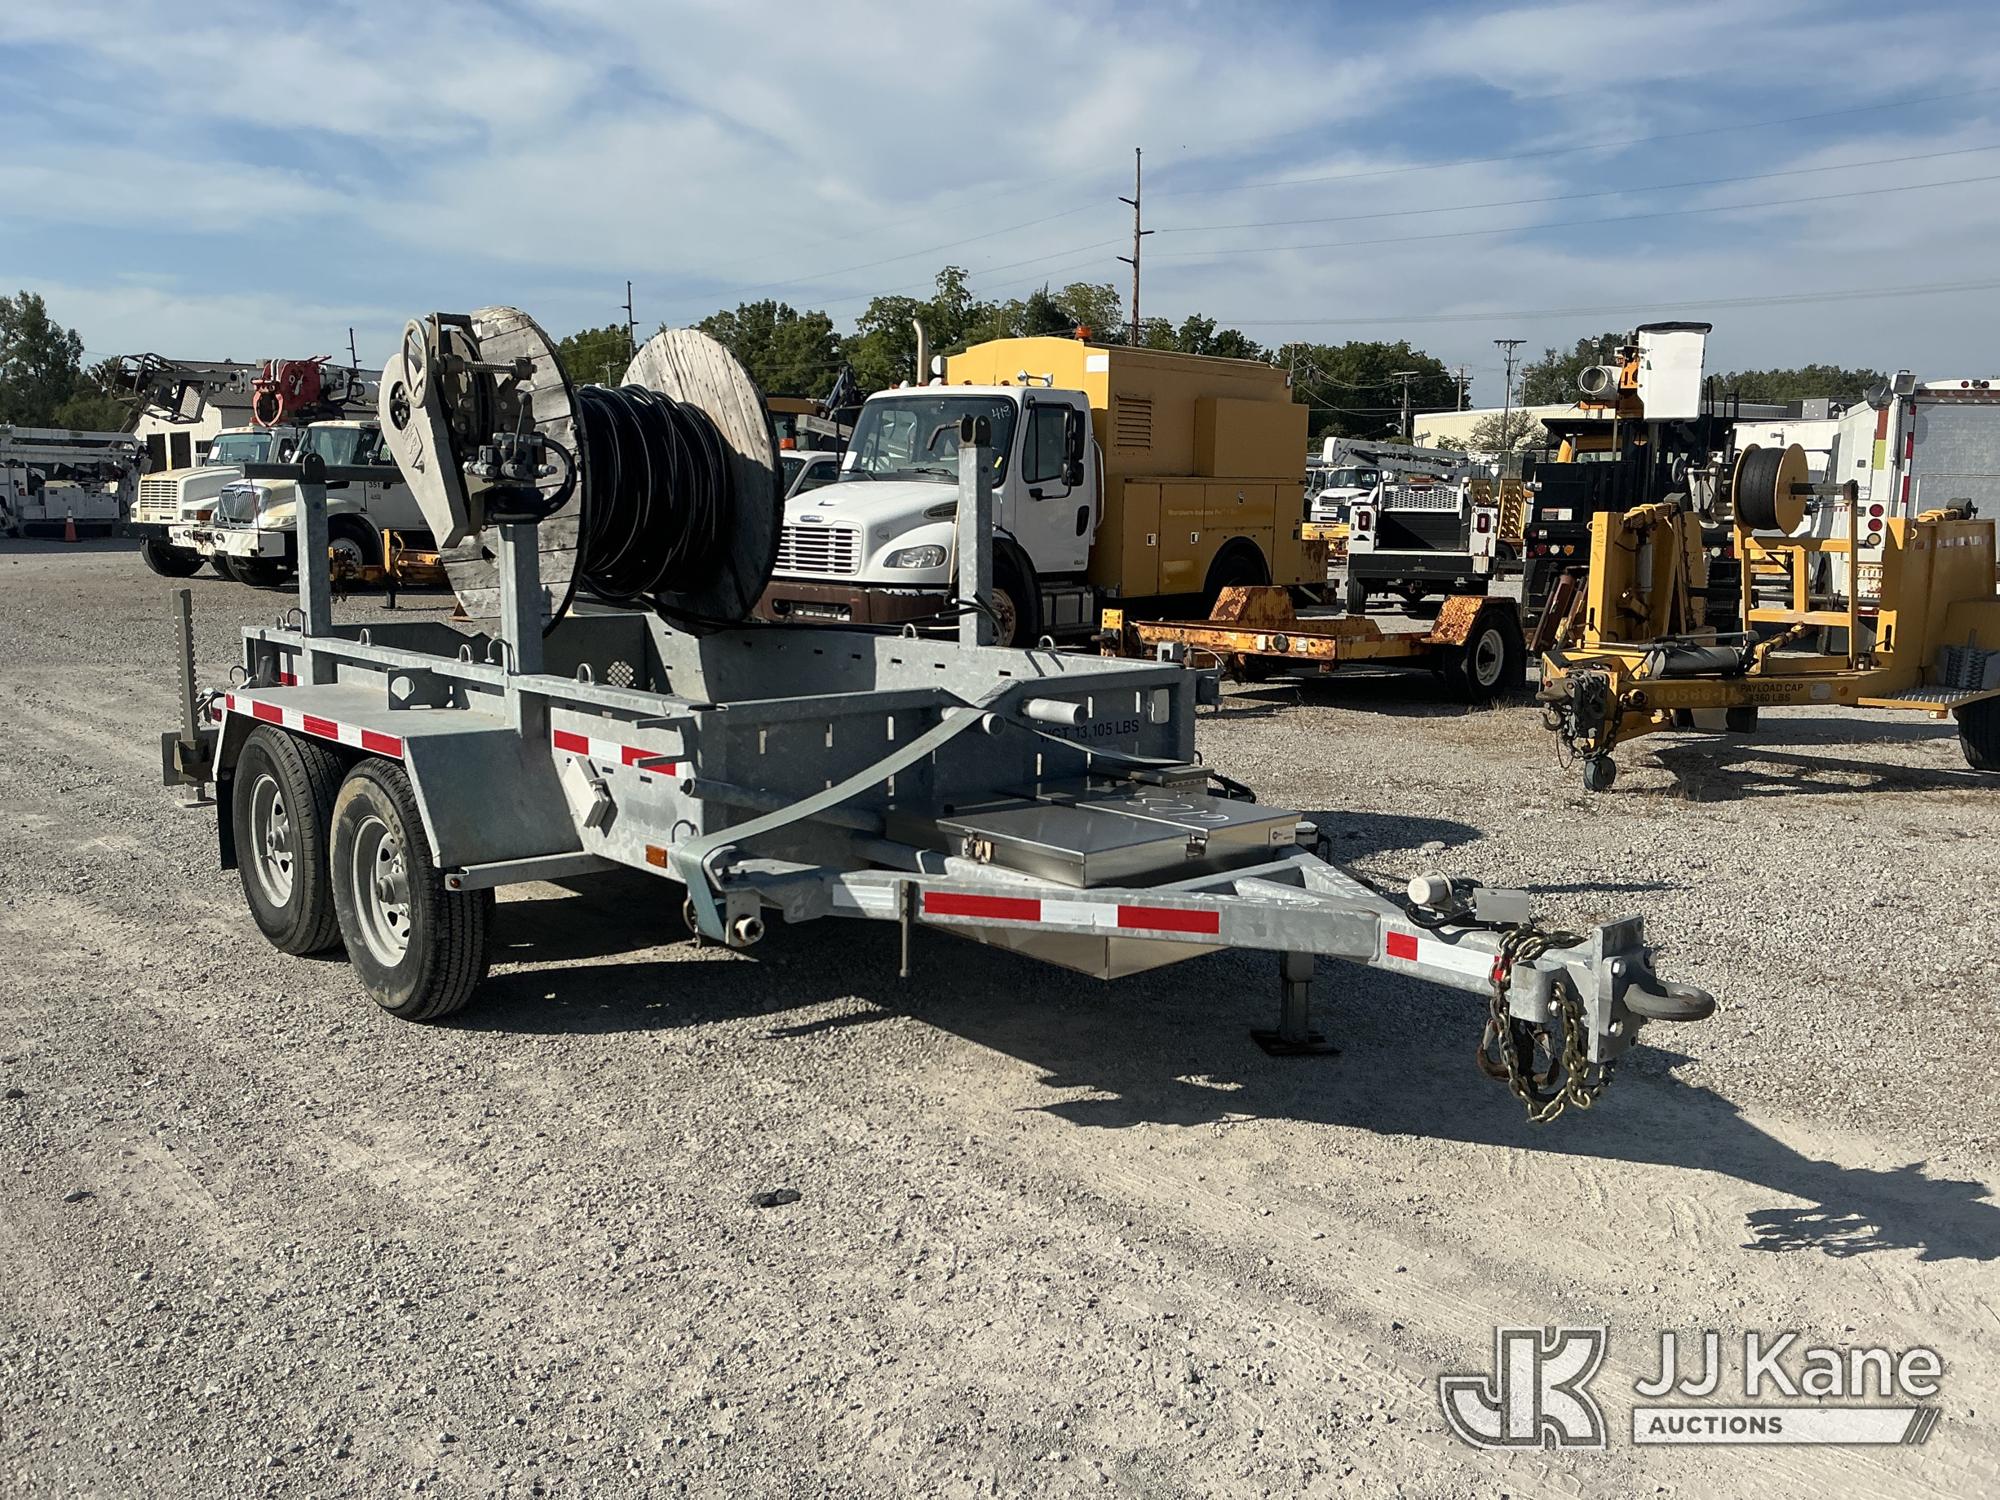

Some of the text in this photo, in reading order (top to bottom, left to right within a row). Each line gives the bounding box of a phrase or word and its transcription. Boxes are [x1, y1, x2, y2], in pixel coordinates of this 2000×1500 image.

[1741, 683, 1803, 693] PAYLOAD CAP
[1772, 693, 1791, 702] LBS
[1076, 722, 1112, 738] 13,105
[1116, 720, 1139, 734] LBS
